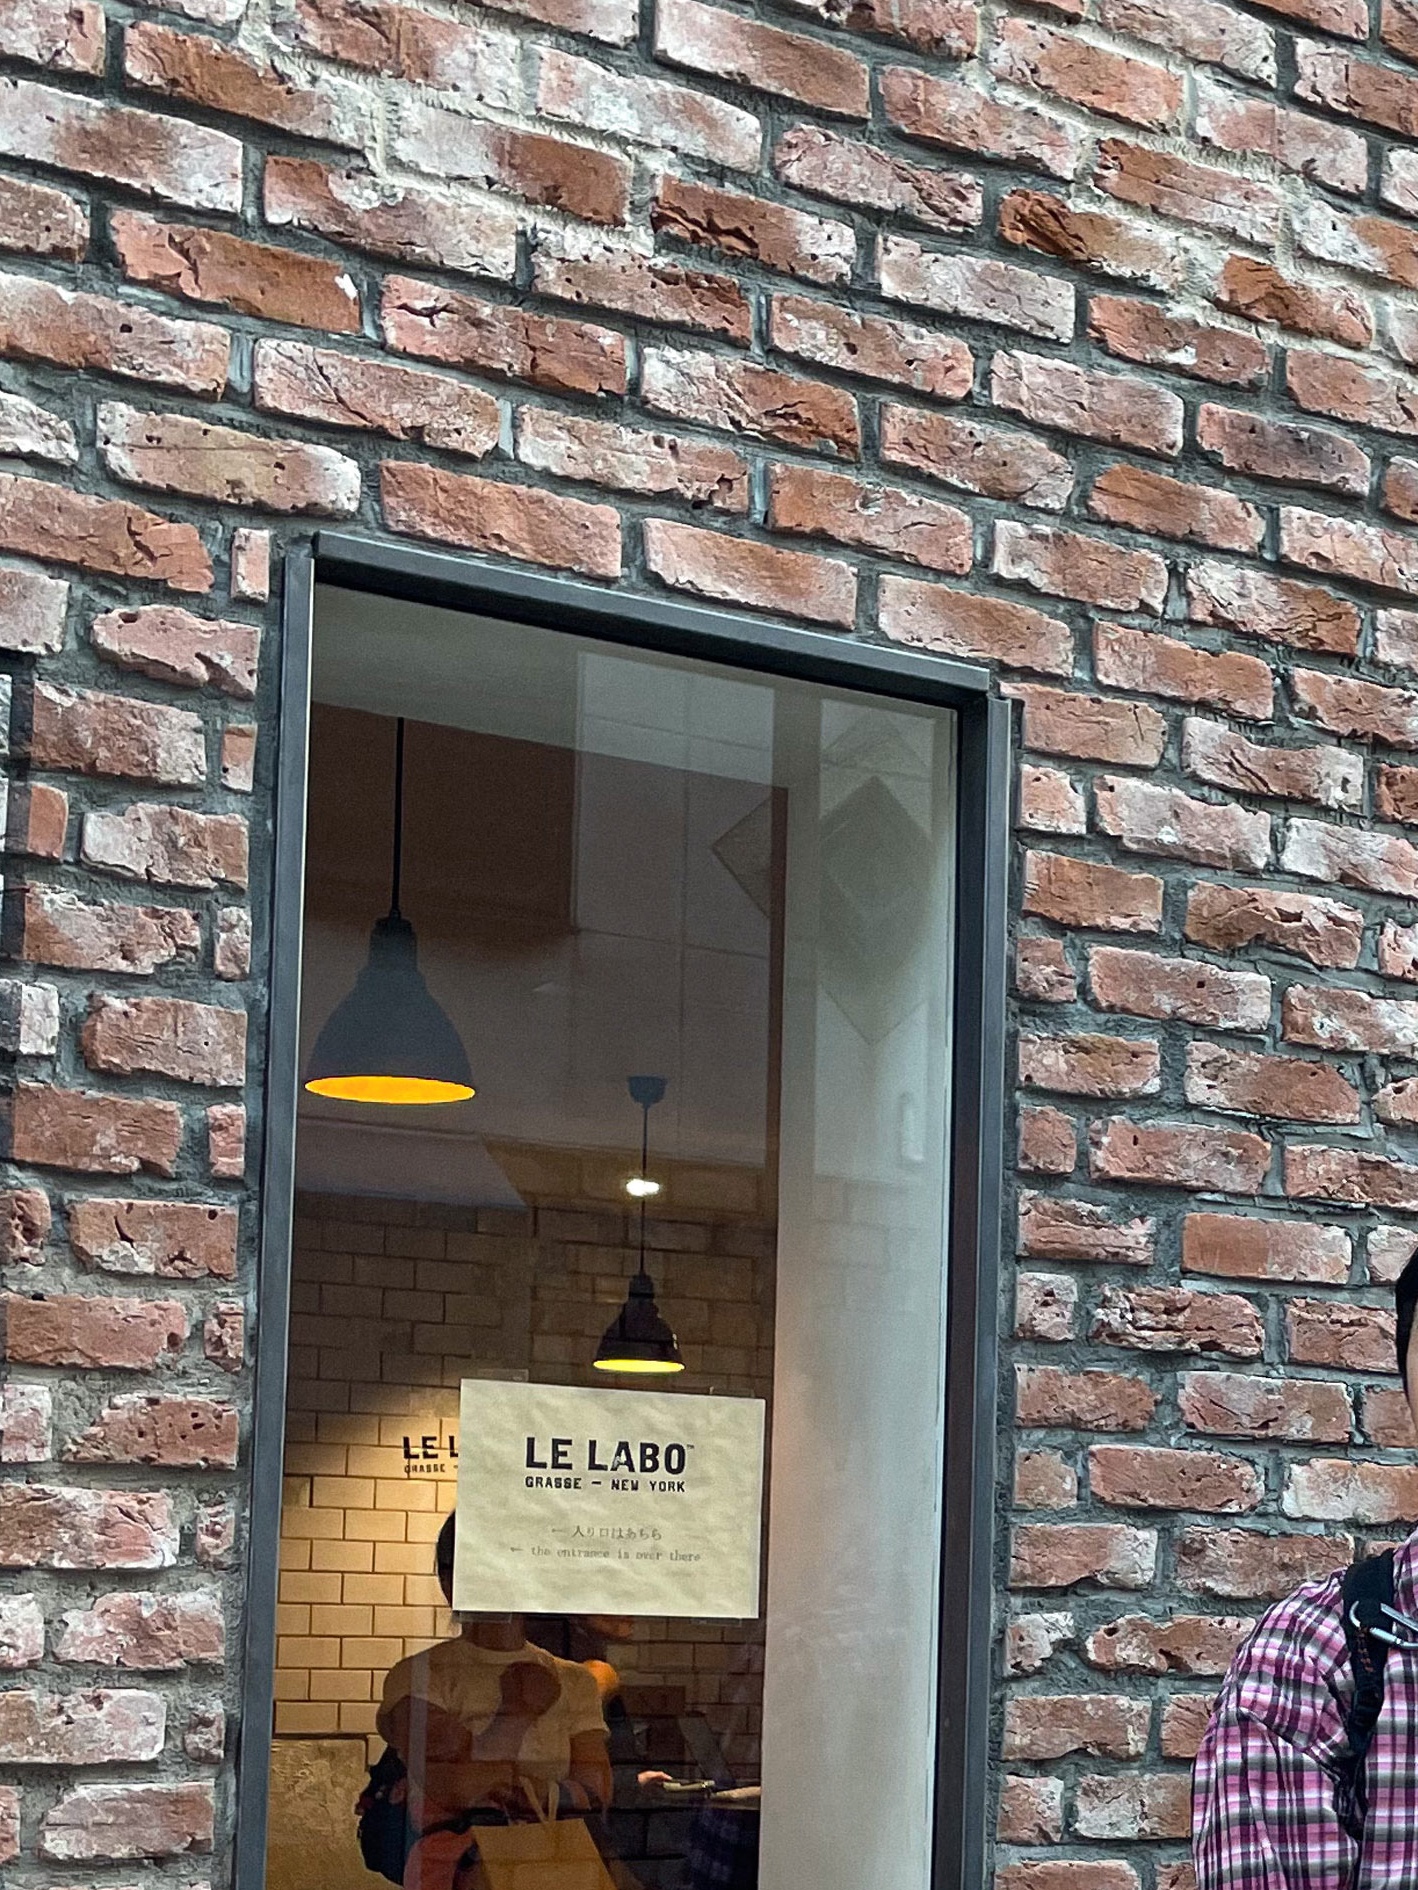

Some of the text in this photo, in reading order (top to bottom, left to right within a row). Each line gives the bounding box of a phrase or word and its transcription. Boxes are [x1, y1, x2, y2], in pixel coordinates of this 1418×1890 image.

[403, 1435, 439, 1460] LE
[525, 1436, 573, 1471] LE
[525, 1475, 582, 1490] GRASSE
[611, 1478, 640, 1492] NEW
[649, 1480, 686, 1493] YORK
[557, 1548, 611, 1559] entrance
[669, 1549, 702, 1562] there
